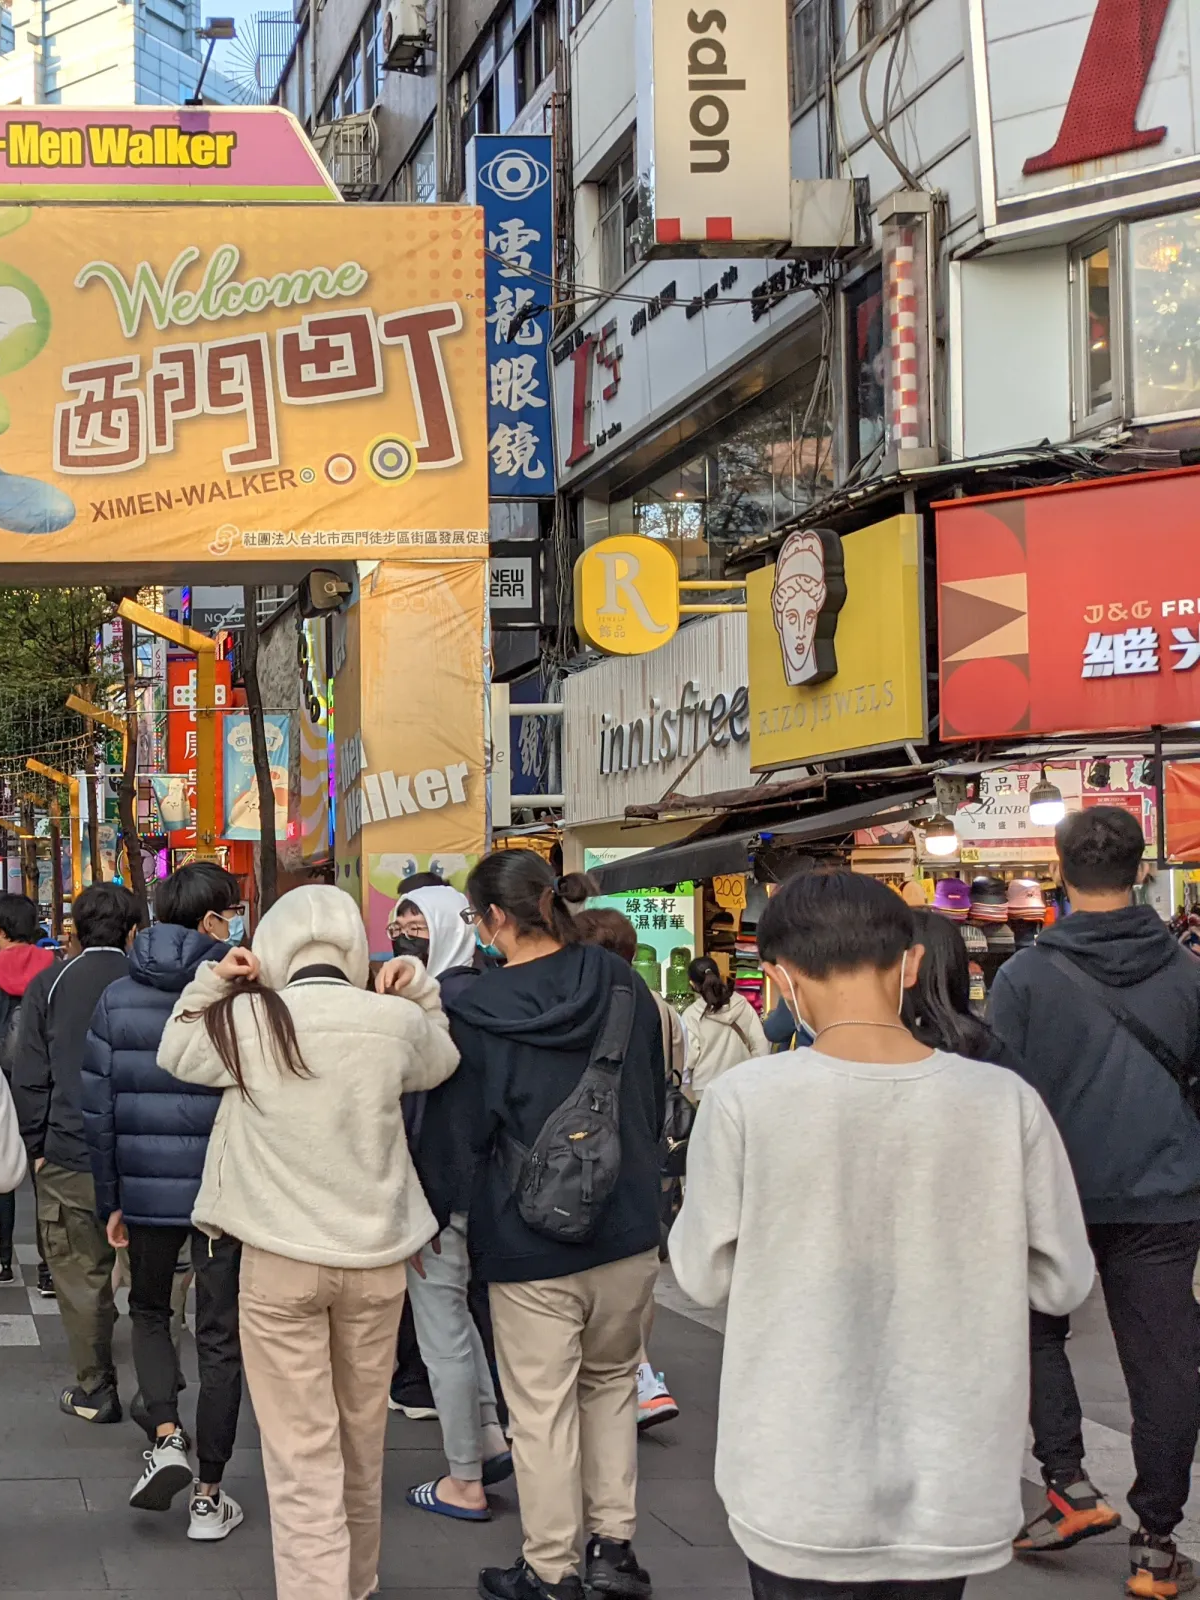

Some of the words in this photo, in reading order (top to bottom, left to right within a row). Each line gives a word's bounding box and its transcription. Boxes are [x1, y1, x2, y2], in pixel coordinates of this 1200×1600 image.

[687, 8, 747, 174] salon
[87, 124, 236, 168] Walker
[74, 243, 369, 338] Welcome
[53, 301, 464, 475] 西門町
[89, 468, 299, 523] XIMEN-WALKER
[490, 569, 524, 583] NEW
[490, 583, 524, 597] ERA
[596, 551, 670, 634] R
[600, 680, 749, 775] innisfree
[758, 703, 807, 736] RIZO
[810, 680, 896, 732] JEWELS
[344, 761, 469, 842] Walker
[961, 796, 1030, 824] RAINBO
[626, 898, 677, 913] 綠茶籽
[714, 876, 744, 897] 200
